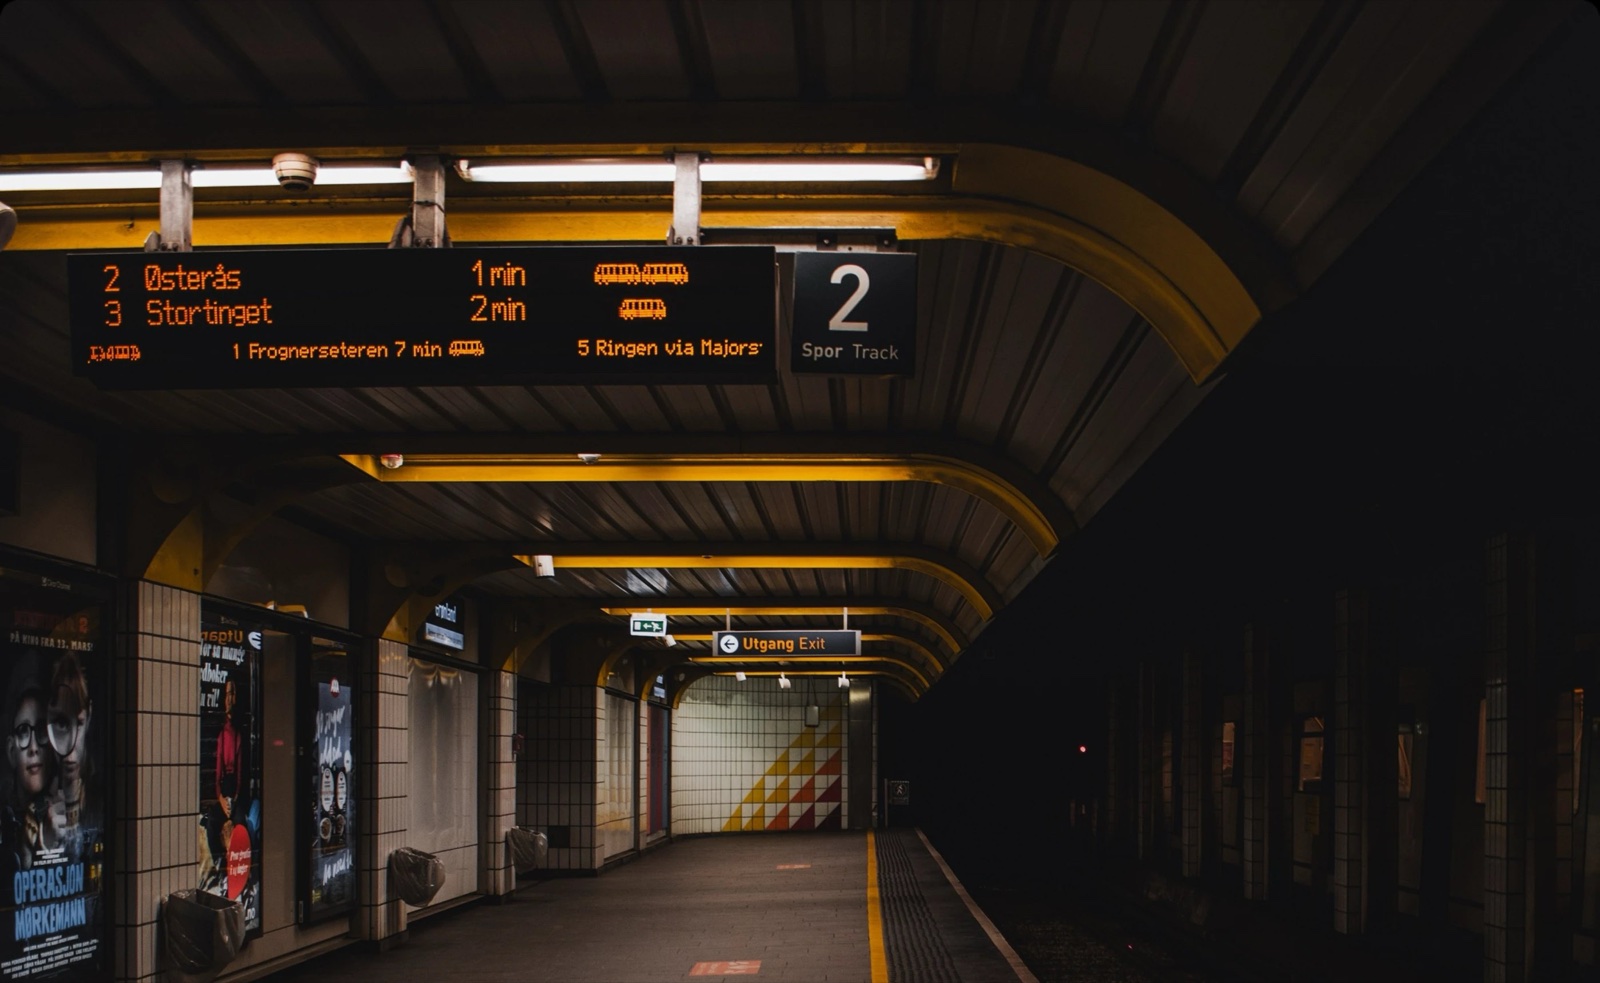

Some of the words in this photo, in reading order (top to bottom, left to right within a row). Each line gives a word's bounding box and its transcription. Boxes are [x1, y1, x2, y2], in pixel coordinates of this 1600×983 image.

[104, 265, 120, 292] 2
[145, 263, 241, 291] Østerås
[471, 259, 483, 287] 1
[490, 262, 526, 287] min
[104, 300, 122, 326] 3
[146, 298, 273, 326] Stortinget
[470, 294, 488, 322] 2
[491, 297, 526, 322] min
[829, 263, 870, 332] 2
[232, 343, 240, 360] 1
[249, 342, 388, 361] Frognerseteren
[394, 340, 406, 358] 7
[413, 340, 442, 358] min
[577, 339, 590, 356] 5
[595, 339, 658, 358] Ringen
[665, 339, 695, 356] via
[700, 338, 763, 358] Majors
[802, 342, 844, 362] Spor
[852, 343, 899, 360] Track
[22, 634, 40, 646] KINO
[40, 636, 55, 648] FRA
[742, 637, 795, 654] Utgang
[799, 637, 826, 650] Exit
[14, 862, 85, 905] OPERASJON
[14, 897, 87, 942] MØRKEMANN
